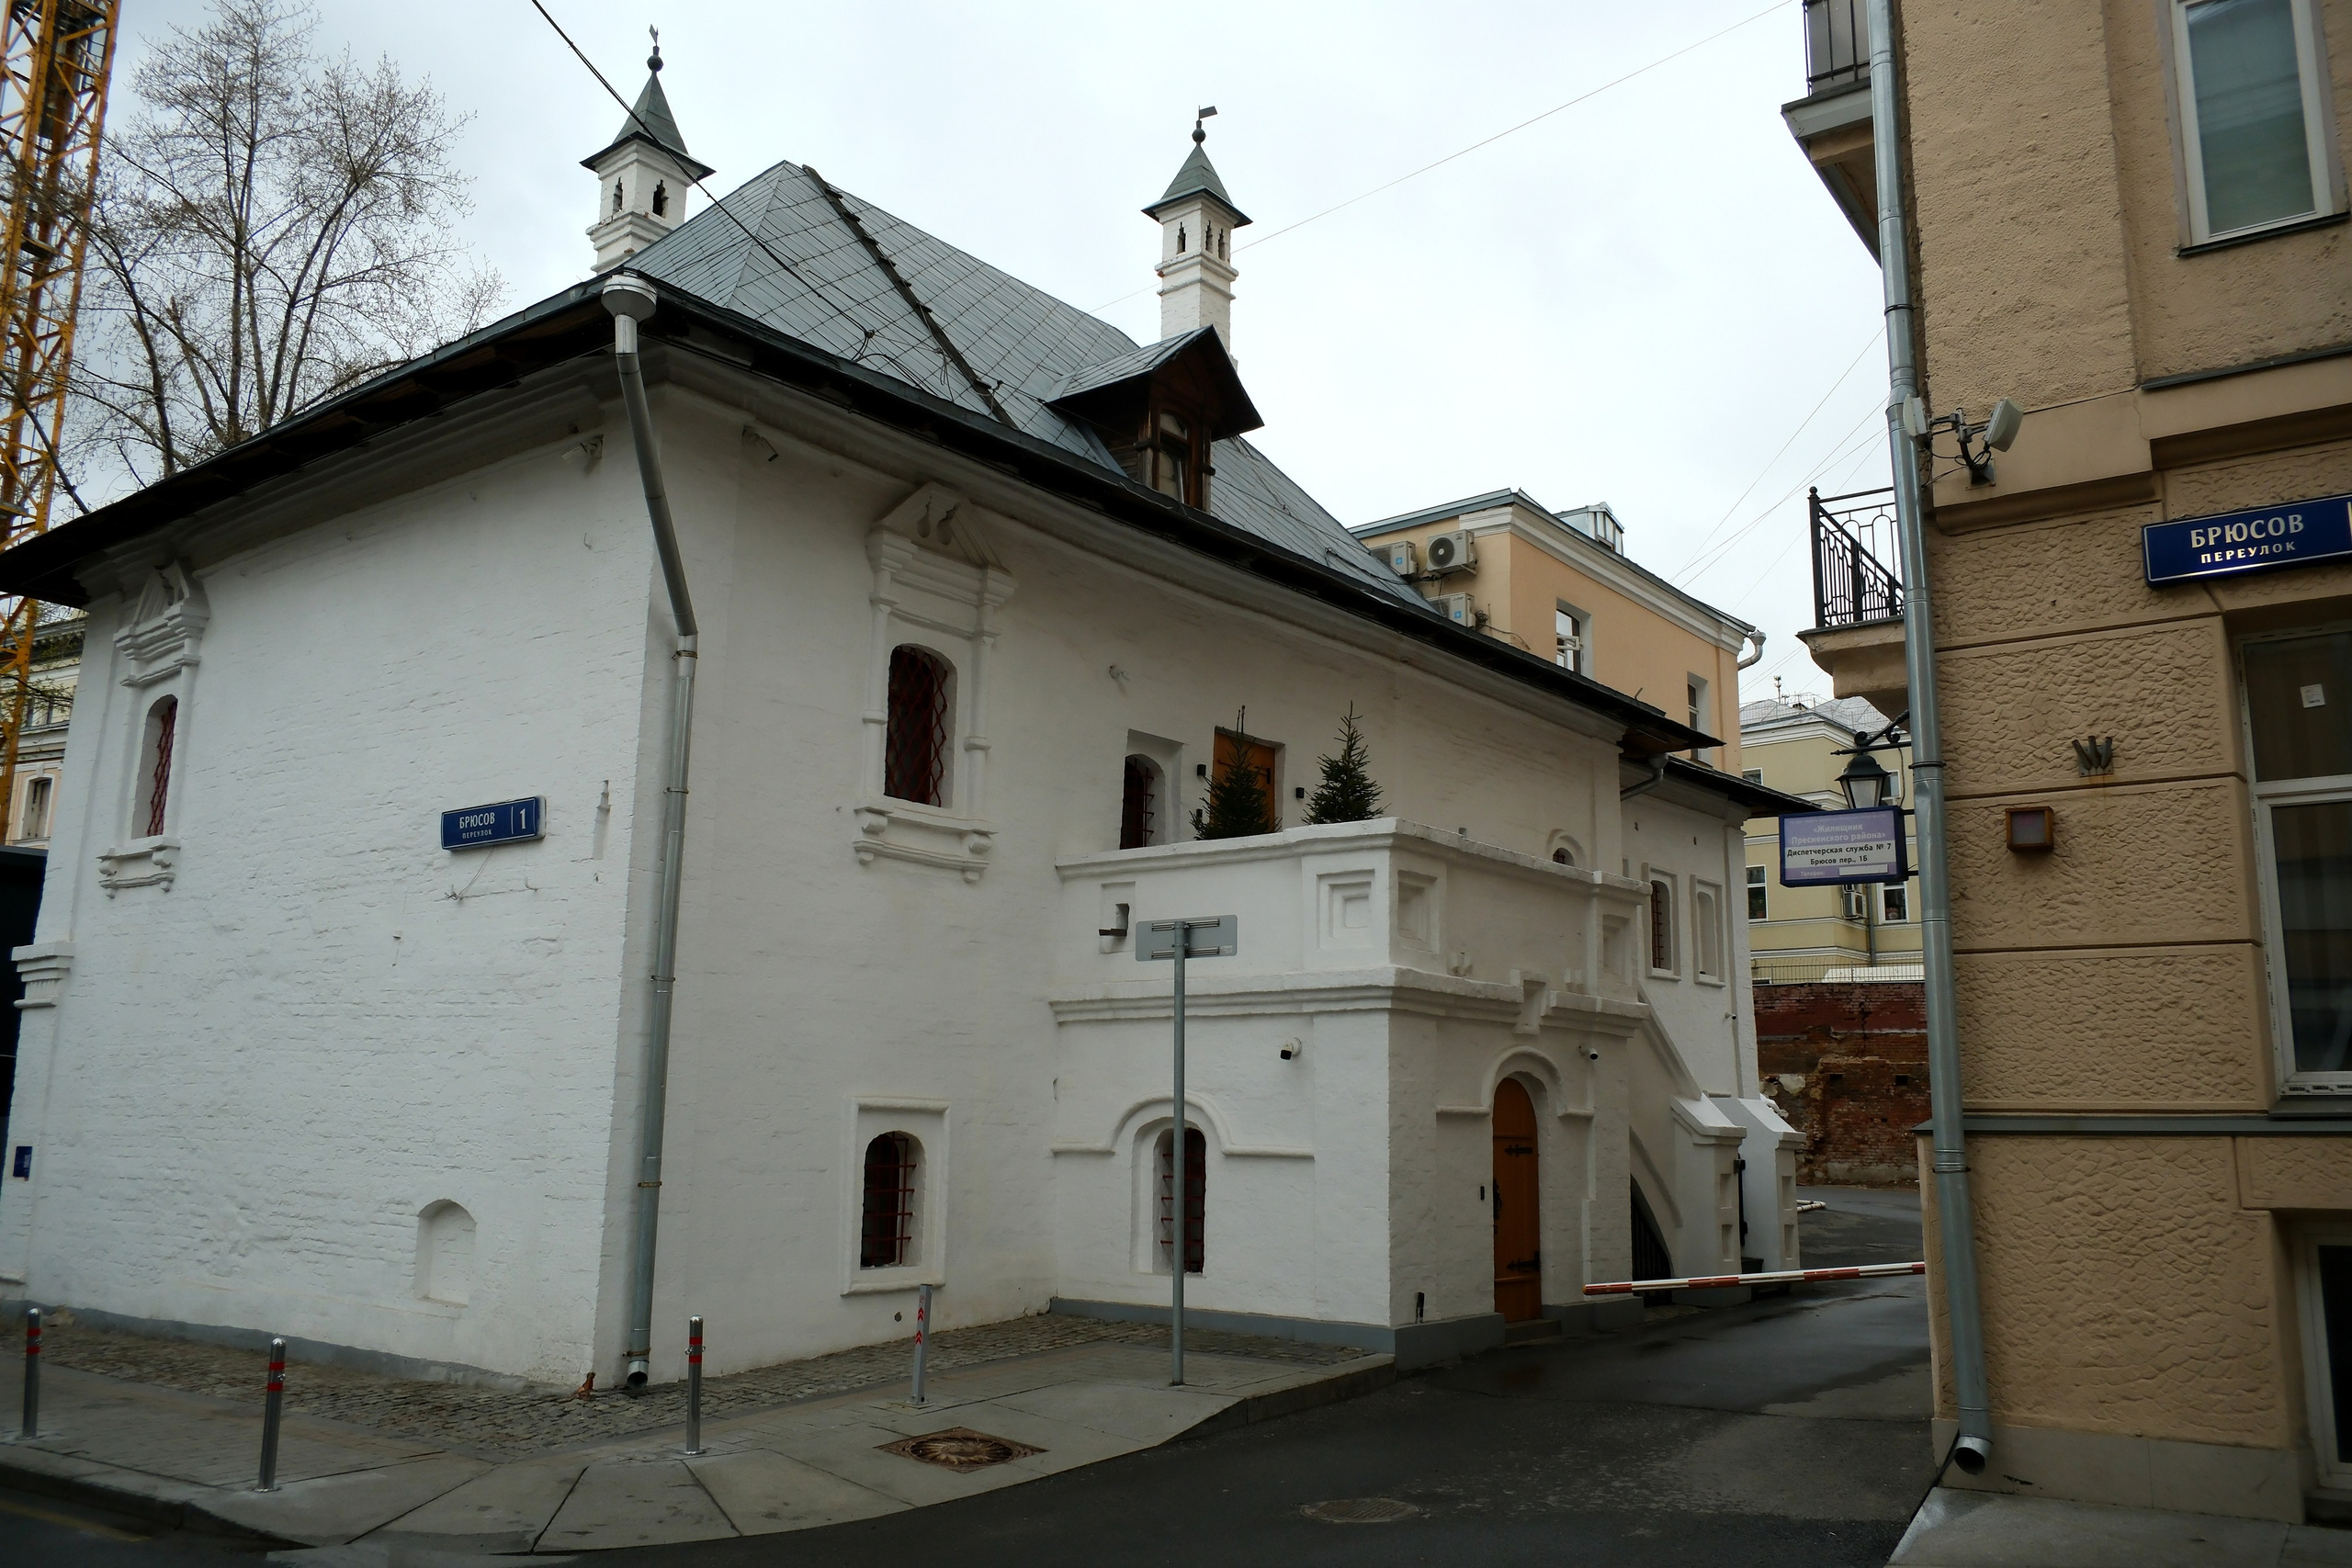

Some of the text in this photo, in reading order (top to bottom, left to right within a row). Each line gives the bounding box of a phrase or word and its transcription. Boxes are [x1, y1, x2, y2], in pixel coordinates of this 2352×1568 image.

[2190, 513, 2304, 548] БРЮСОВ
[2200, 541, 2295, 564] ПЕРЕУЛОК
[459, 808, 526, 829] БРЮСОВ 1
[462, 829, 492, 839] ПЕРЕУЛОК
[1813, 823, 1863, 833] «Жилищник
[1791, 831, 1886, 845] Пресненского района»
[1787, 846, 1843, 858] Диспетчерская
[1845, 844, 1873, 854] служба
[1810, 857, 1837, 866] Брюсов
